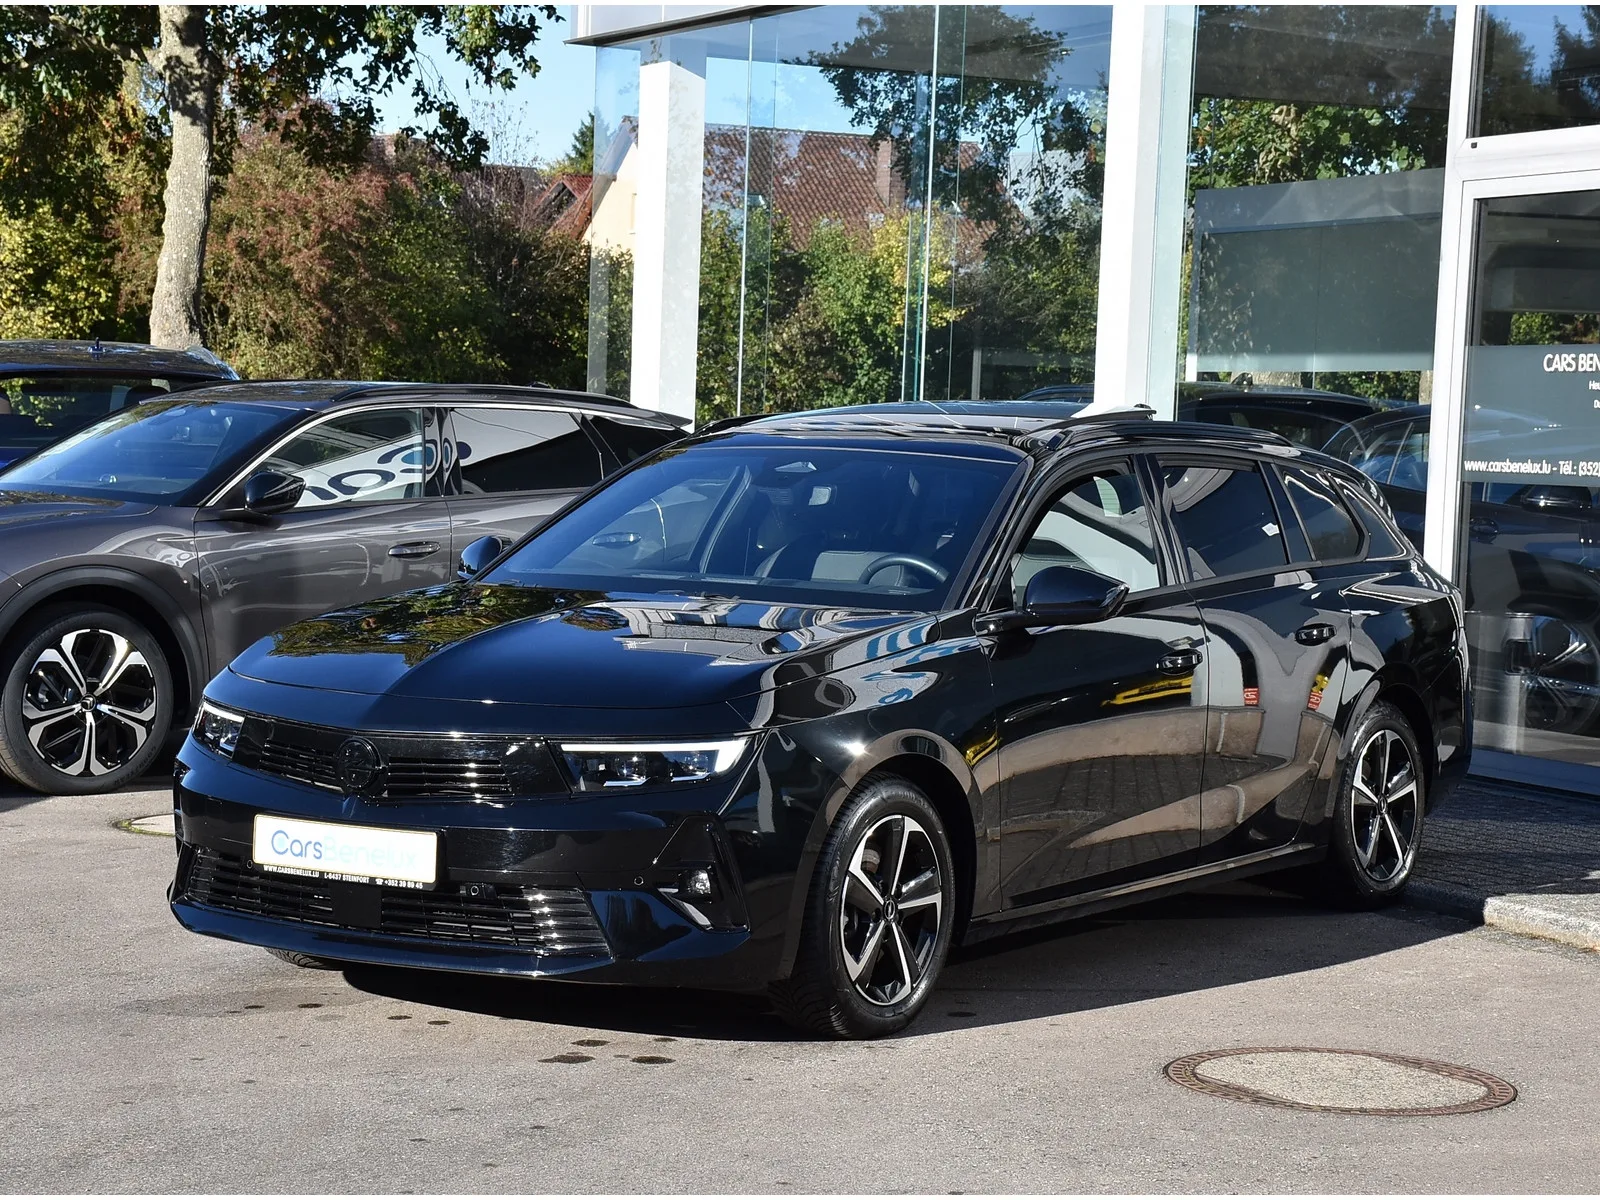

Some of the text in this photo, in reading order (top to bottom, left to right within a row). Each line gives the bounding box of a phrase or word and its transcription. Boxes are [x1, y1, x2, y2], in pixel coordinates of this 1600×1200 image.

[1543, 353, 1600, 372] CARS BEN
[1464, 458, 1551, 475] www.carsbenelux.lu
[270, 829, 416, 869] CarsBenelux
